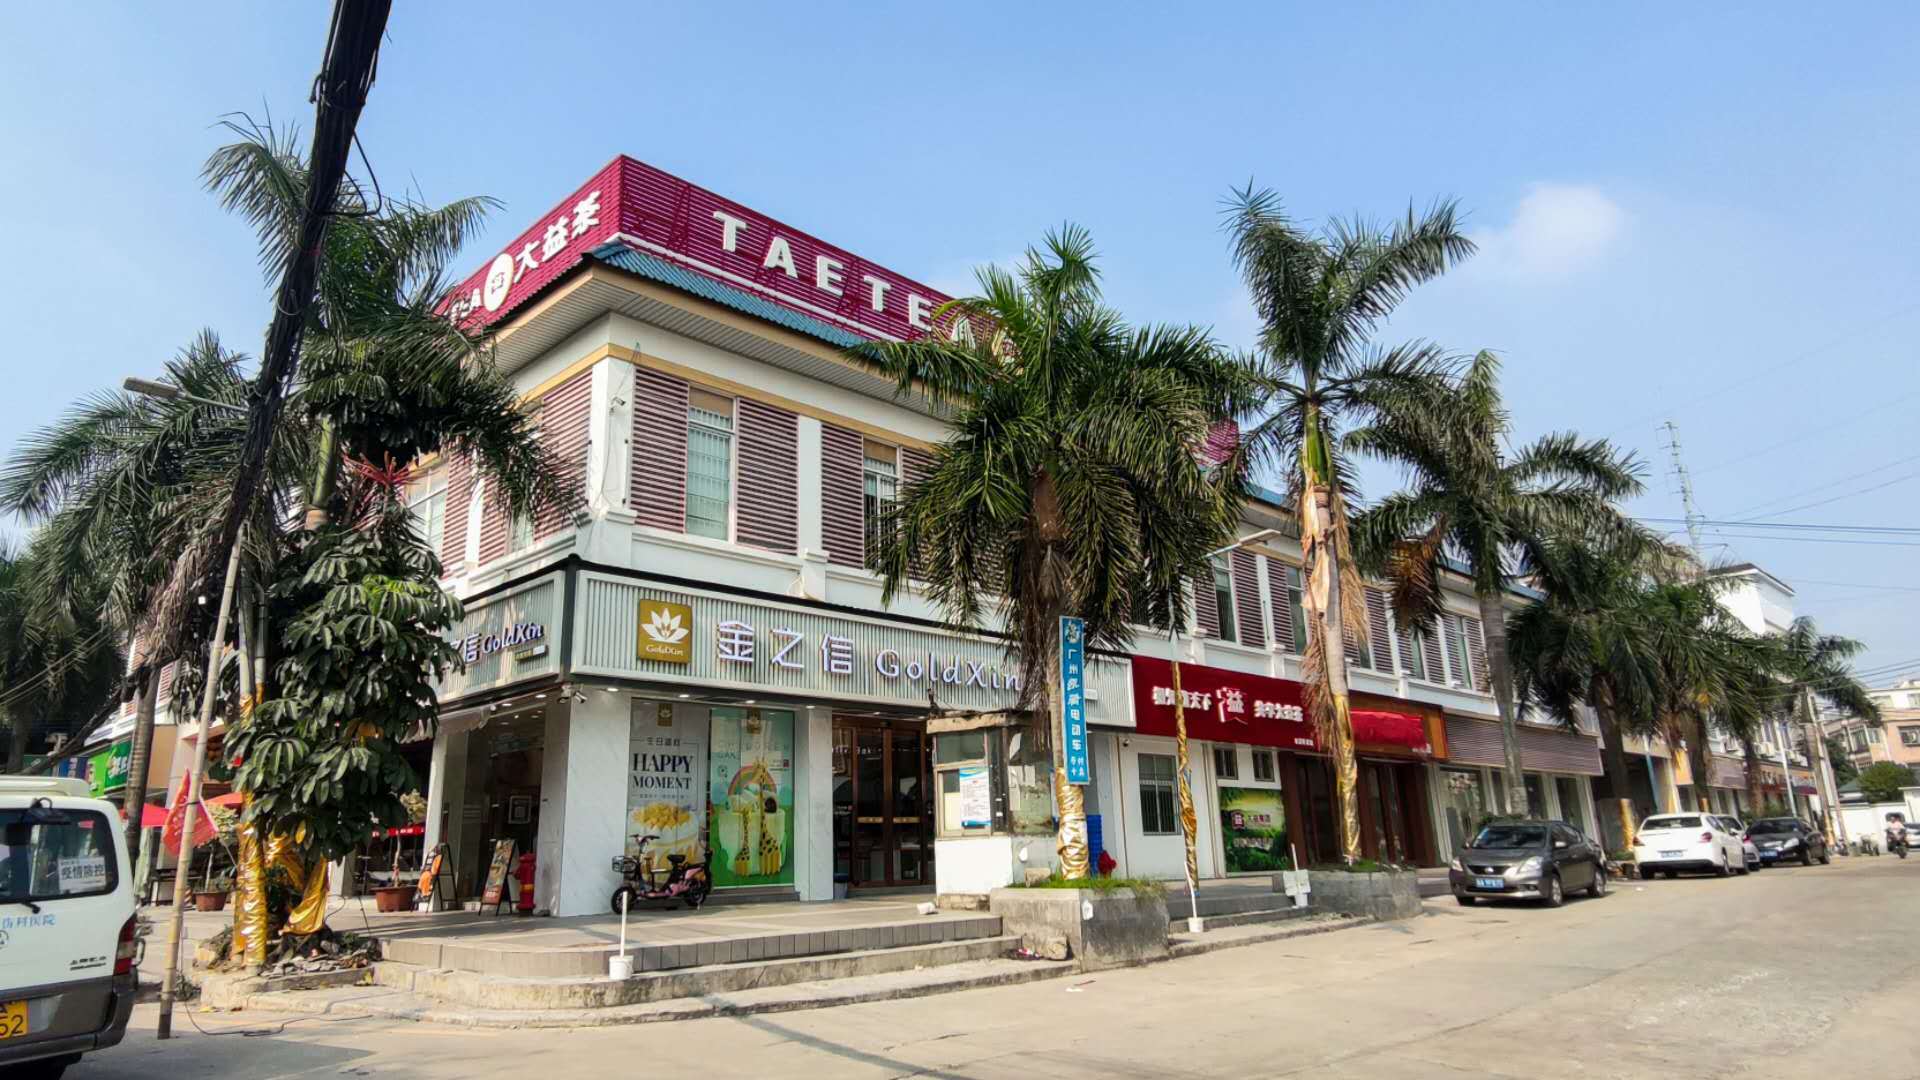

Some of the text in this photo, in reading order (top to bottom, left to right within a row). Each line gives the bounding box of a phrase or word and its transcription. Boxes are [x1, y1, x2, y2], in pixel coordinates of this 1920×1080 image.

[513, 190, 601, 284] 大益茶
[713, 211, 977, 351] TAETEA
[482, 622, 543, 654] GoldXin
[717, 619, 854, 675] 金之信
[875, 648, 1021, 691] GoldXin
[632, 752, 694, 773] HAPPY
[632, 775, 693, 790] MOMENT
